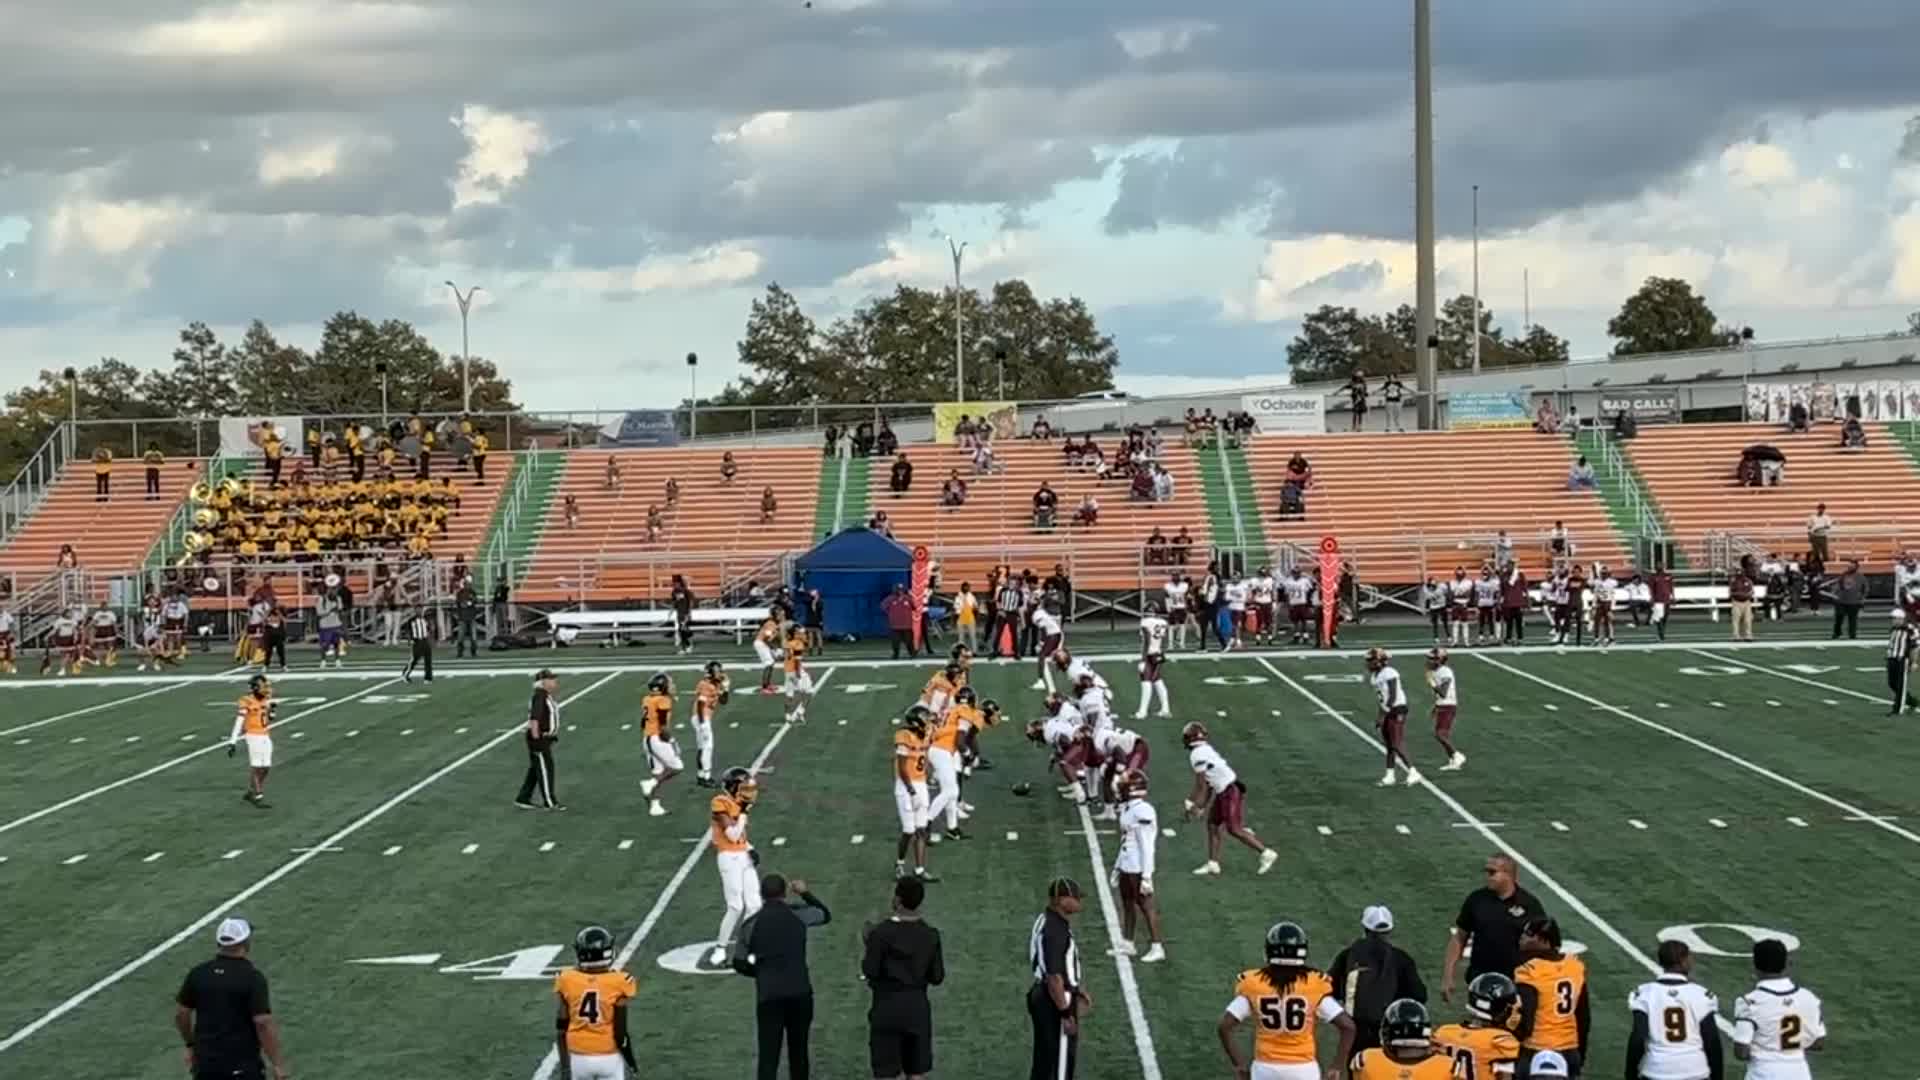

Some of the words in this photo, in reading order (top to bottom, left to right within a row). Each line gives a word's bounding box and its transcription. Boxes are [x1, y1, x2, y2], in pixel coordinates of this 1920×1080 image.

[1260, 399, 1317, 410] Ochsner
[577, 990, 601, 1025] 4
[1258, 997, 1308, 1031] 56
[1556, 979, 1581, 1015] 3
[1664, 1006, 1687, 1043] 9
[1780, 1014, 1801, 1049] 2
